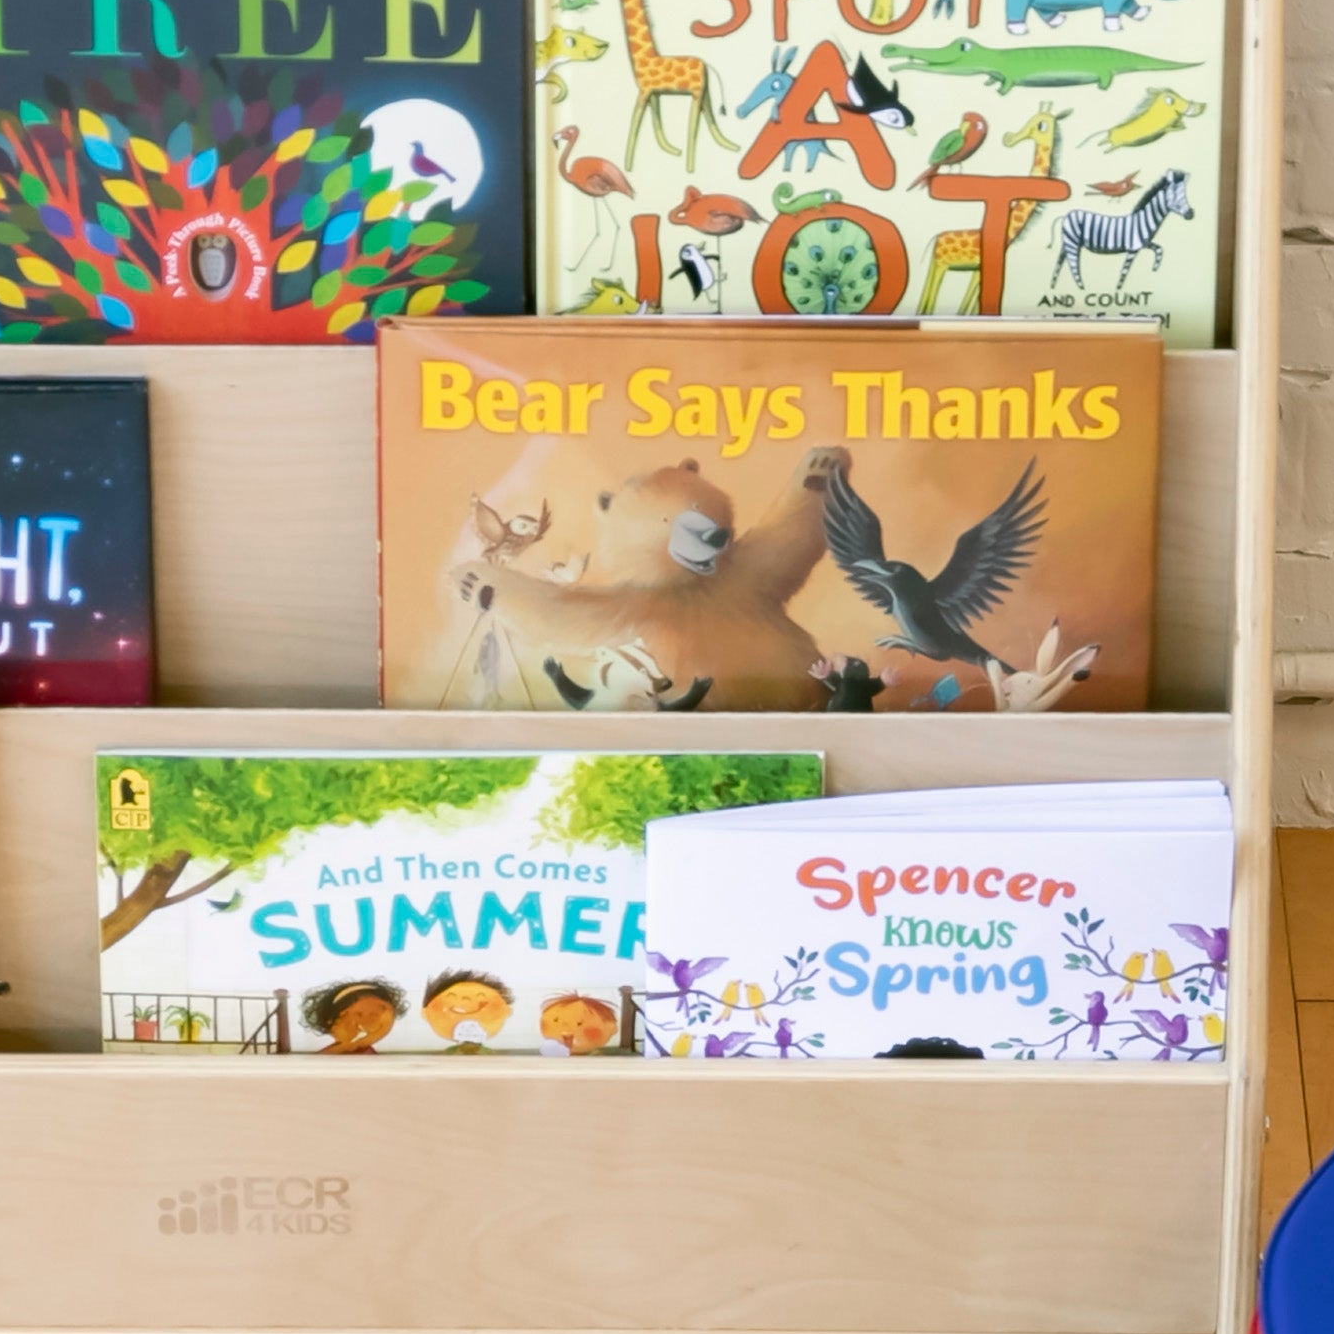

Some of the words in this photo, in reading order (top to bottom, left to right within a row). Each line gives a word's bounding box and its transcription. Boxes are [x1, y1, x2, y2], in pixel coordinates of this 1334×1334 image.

[738, 40, 896, 190] A
[228, 217, 263, 262] Picture
[173, 286, 187, 298] A
[244, 265, 267, 299] Book
[1037, 294, 1075, 308] AND
[1084, 291, 1153, 307] COUNT
[420, 361, 604, 433] Bear
[627, 369, 805, 457] Says
[832, 369, 1121, 441] Thanks
[317, 856, 384, 890] And
[394, 854, 480, 881] Then
[493, 854, 608, 884] Comes
[796, 856, 1076, 915] Spencer
[883, 915, 1019, 950] knows
[824, 941, 1049, 1011] Spring
[243, 1177, 351, 1210] ECR
